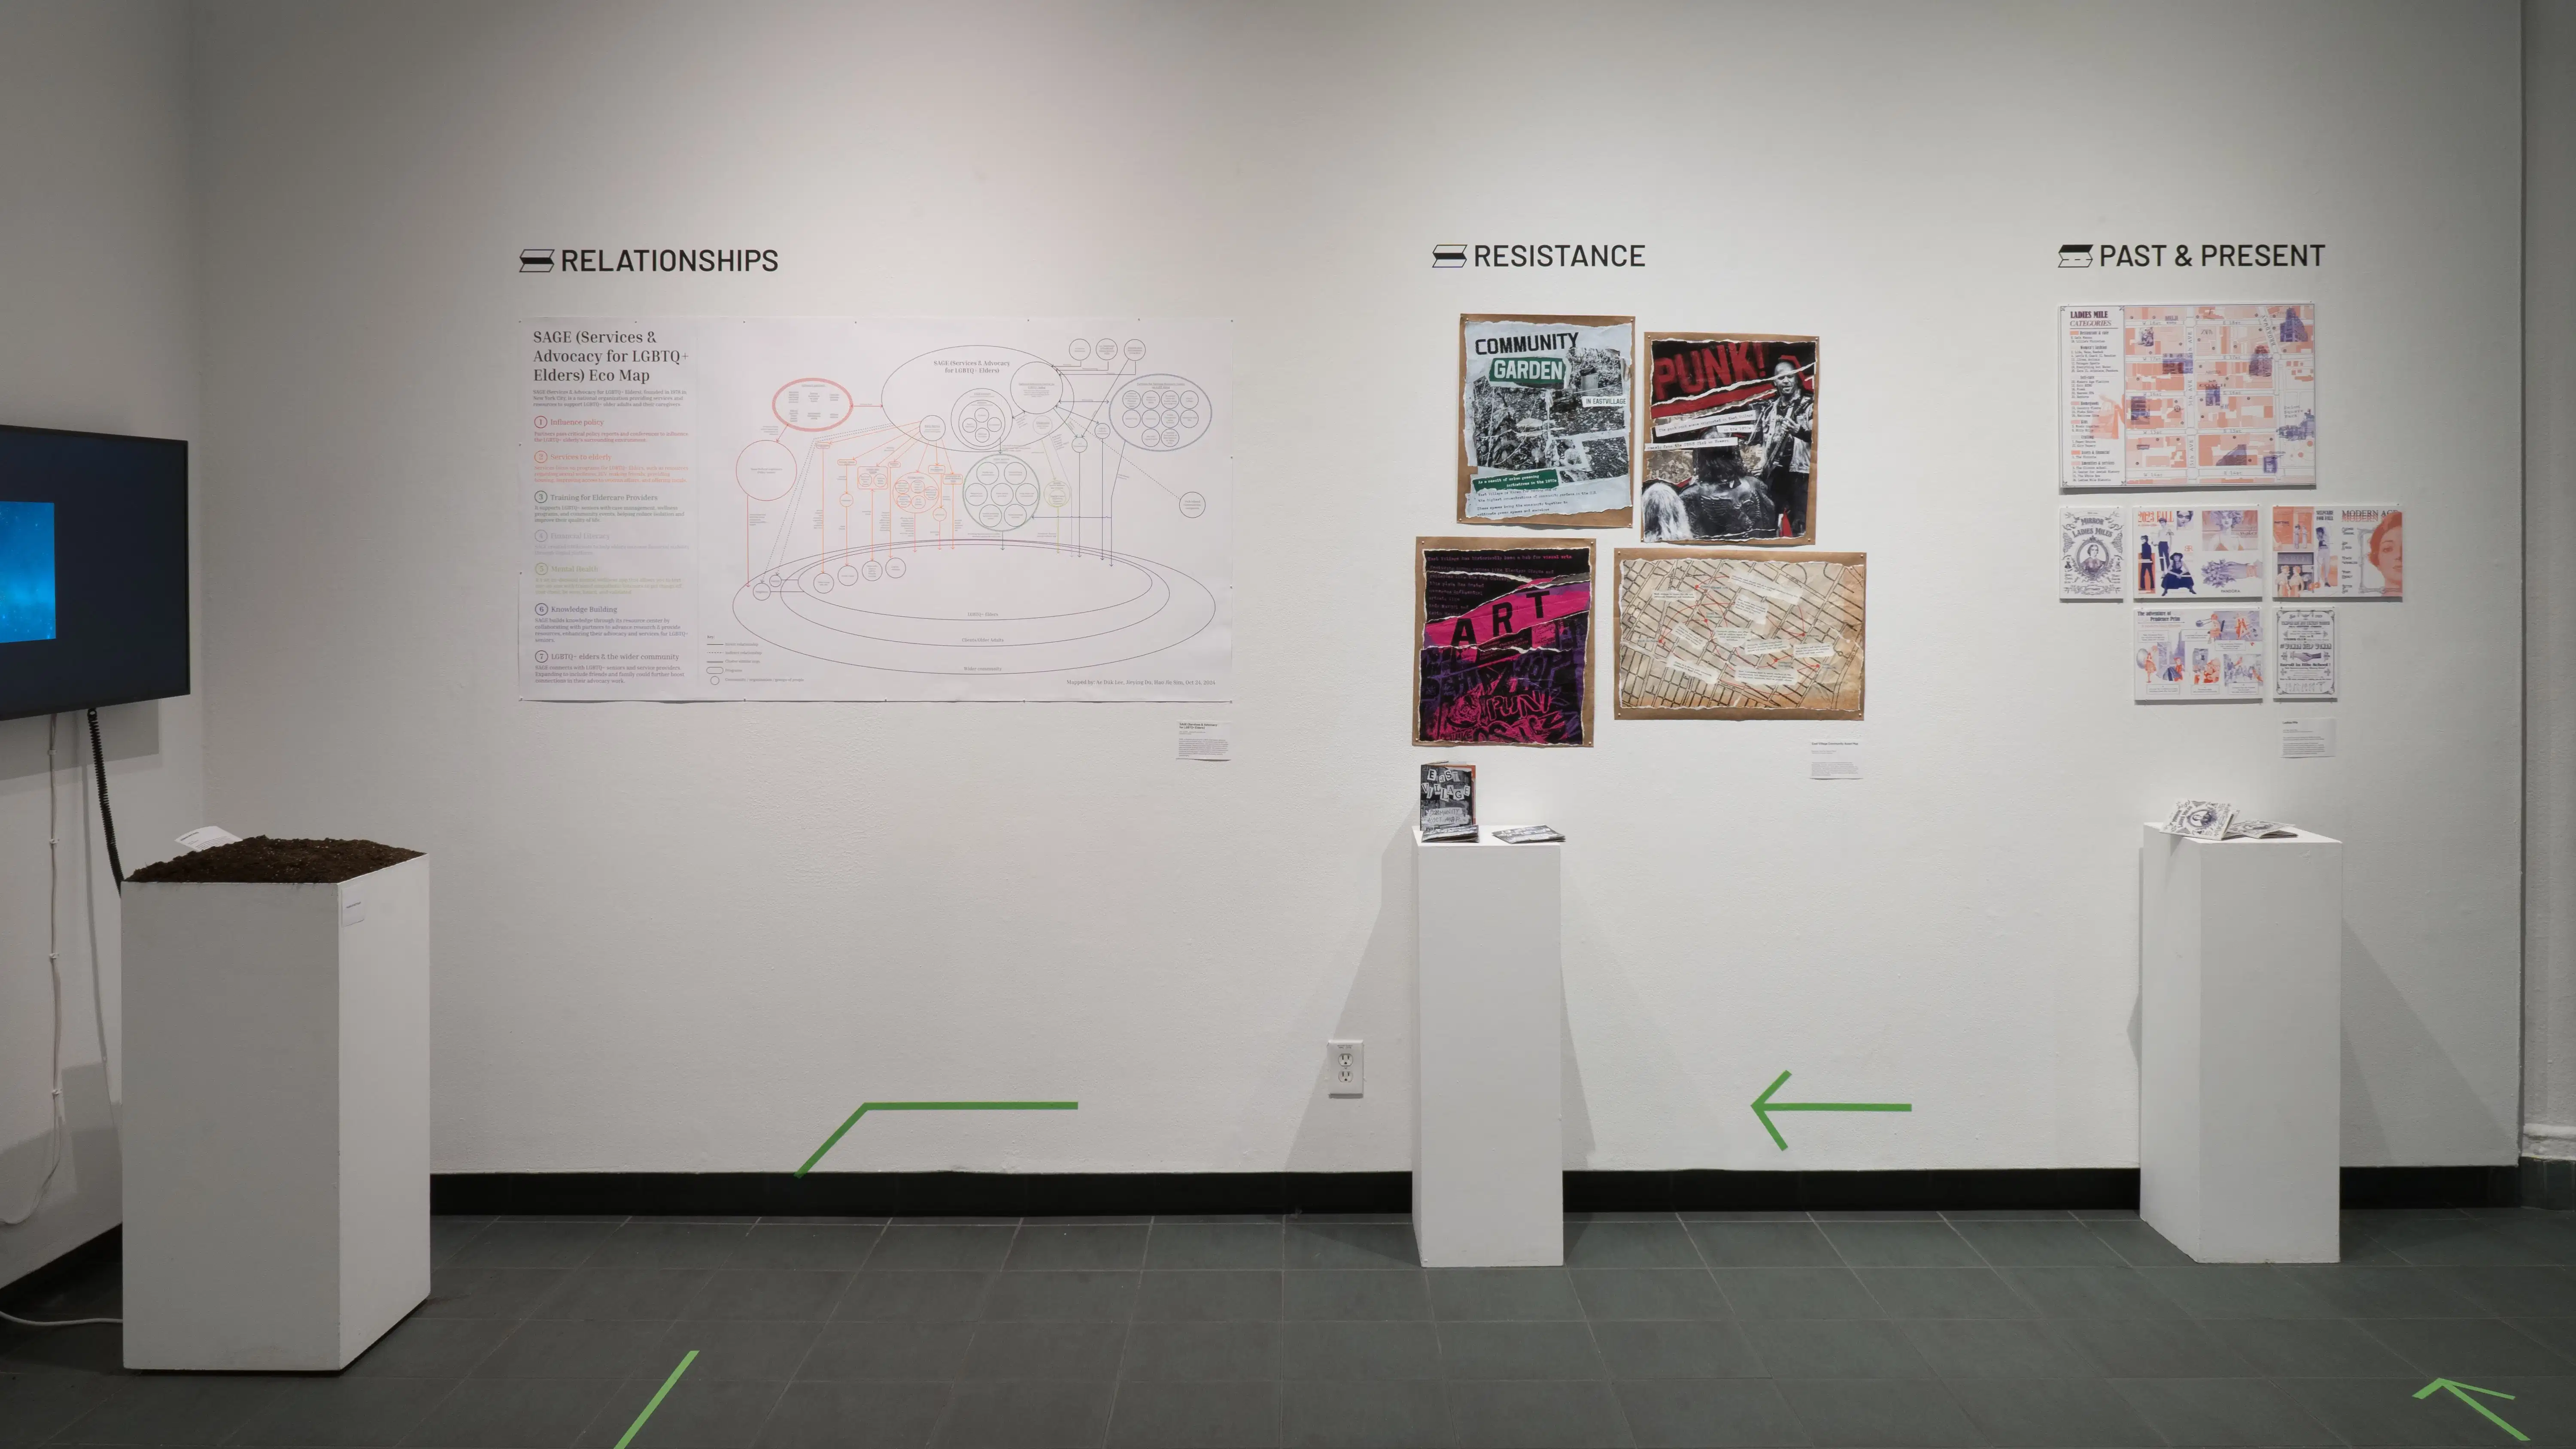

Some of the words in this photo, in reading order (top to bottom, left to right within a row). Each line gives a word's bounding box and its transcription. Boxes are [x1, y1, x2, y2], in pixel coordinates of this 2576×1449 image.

[562, 249, 778, 272] RELATIONSHIPS
[1475, 245, 1646, 267] RESISTANCE
[2100, 244, 2167, 267] PAST
[2175, 245, 2193, 267] &
[2202, 244, 2326, 267] PRESENT
[533, 331, 571, 343] SAGE
[576, 330, 644, 345] (Services
[647, 331, 657, 343] &
[1476, 332, 1579, 355] COMMUNITY
[533, 349, 603, 365] Advocacy
[606, 349, 629, 362] for
[632, 350, 689, 365] LGBTQ+
[534, 368, 584, 383] Elders)
[589, 369, 615, 381] Eco
[619, 369, 650, 384] Map
[1494, 360, 1562, 380] GARDEN
[1654, 342, 1767, 400] PUNK!
[2138, 511, 2155, 522] 2023
[2072, 527, 2094, 537] LADIES
[2095, 527, 2113, 537] MILES
[1451, 590, 1550, 662] ART
[1422, 783, 1469, 799] VILLAGE
[1430, 808, 1460, 816] COMMUNITY
